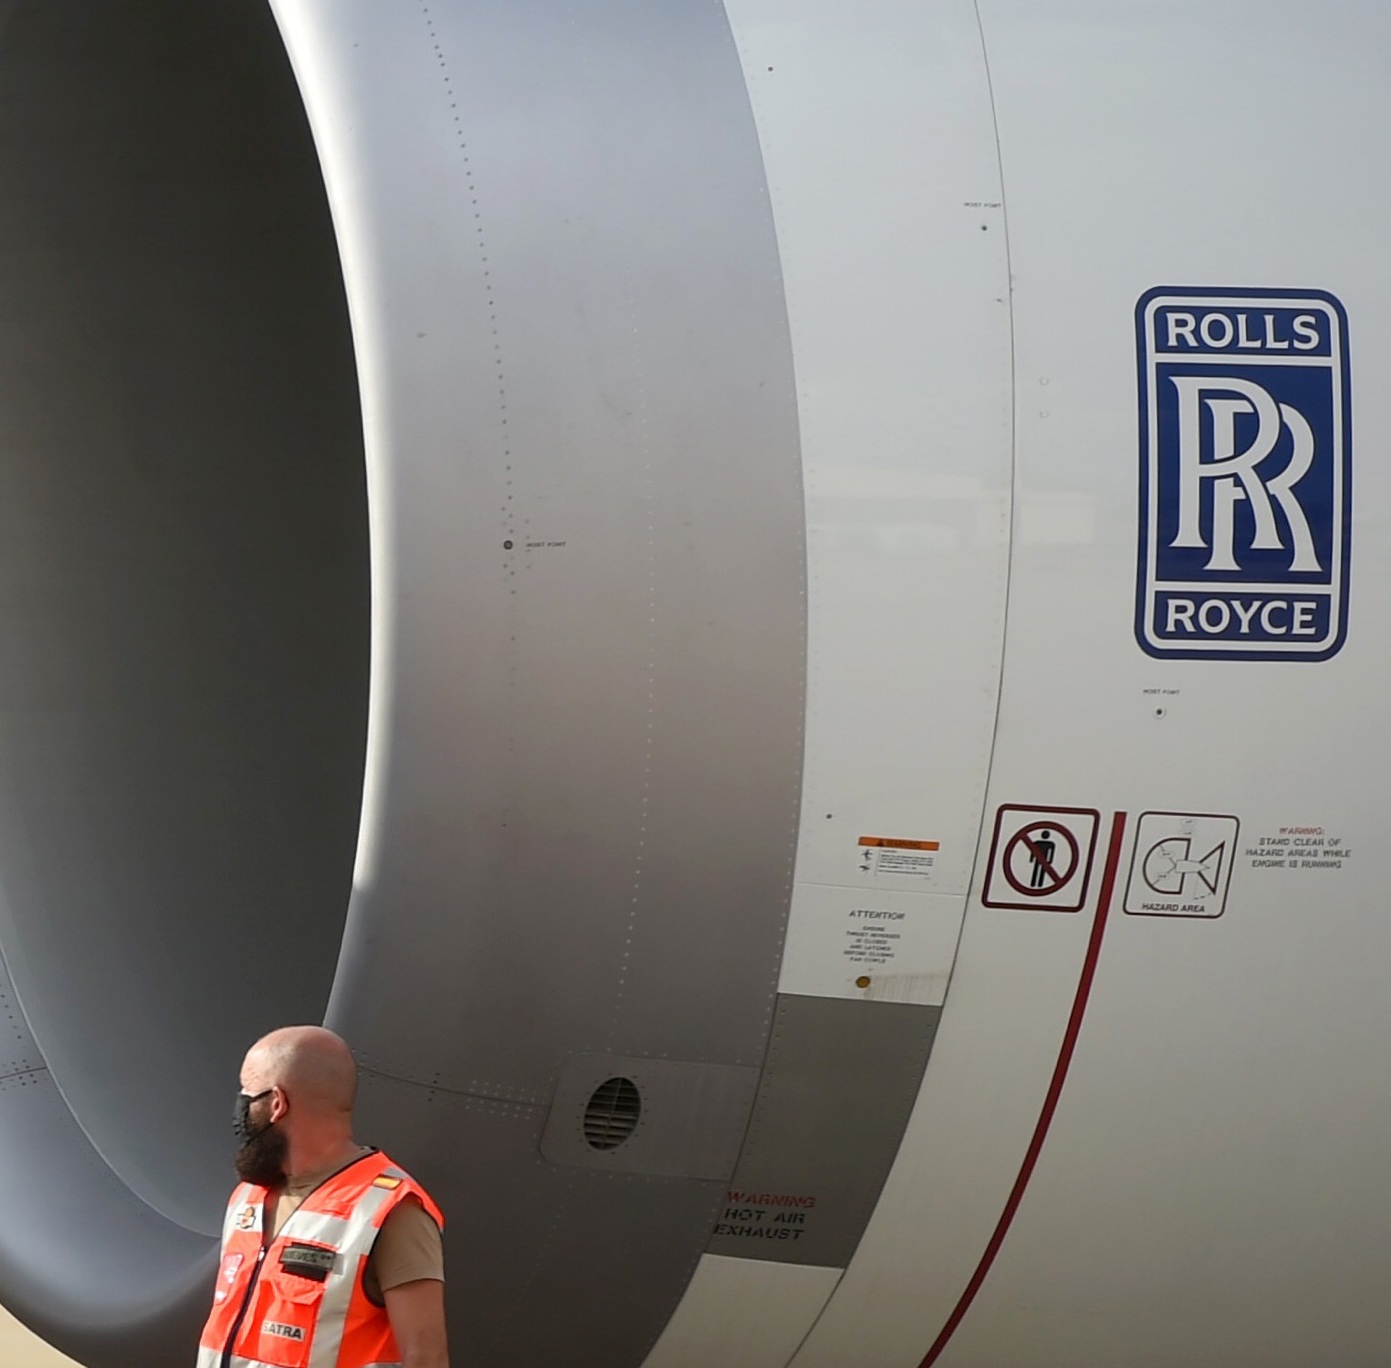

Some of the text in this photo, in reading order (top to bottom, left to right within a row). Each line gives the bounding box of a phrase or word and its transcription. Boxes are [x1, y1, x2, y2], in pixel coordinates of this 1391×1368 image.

[1165, 312, 1320, 350] ROLLS
[1168, 376, 1323, 572] RR
[1165, 598, 1318, 635] ROYCE
[1258, 838, 1342, 846] STAND CLEAR OF
[1245, 849, 1352, 858] HAZARD AREAS WHILE
[1252, 860, 1286, 868] ENGINE
[1288, 860, 1298, 868] IS
[849, 910, 906, 920] ATTENTION
[1142, 903, 1206, 913] HAZARD AREA
[727, 1191, 816, 1208] WARNING
[724, 1208, 806, 1224] HOT AIR
[713, 1223, 805, 1240] EXHAUST
[263, 1322, 302, 1340] SATRA
